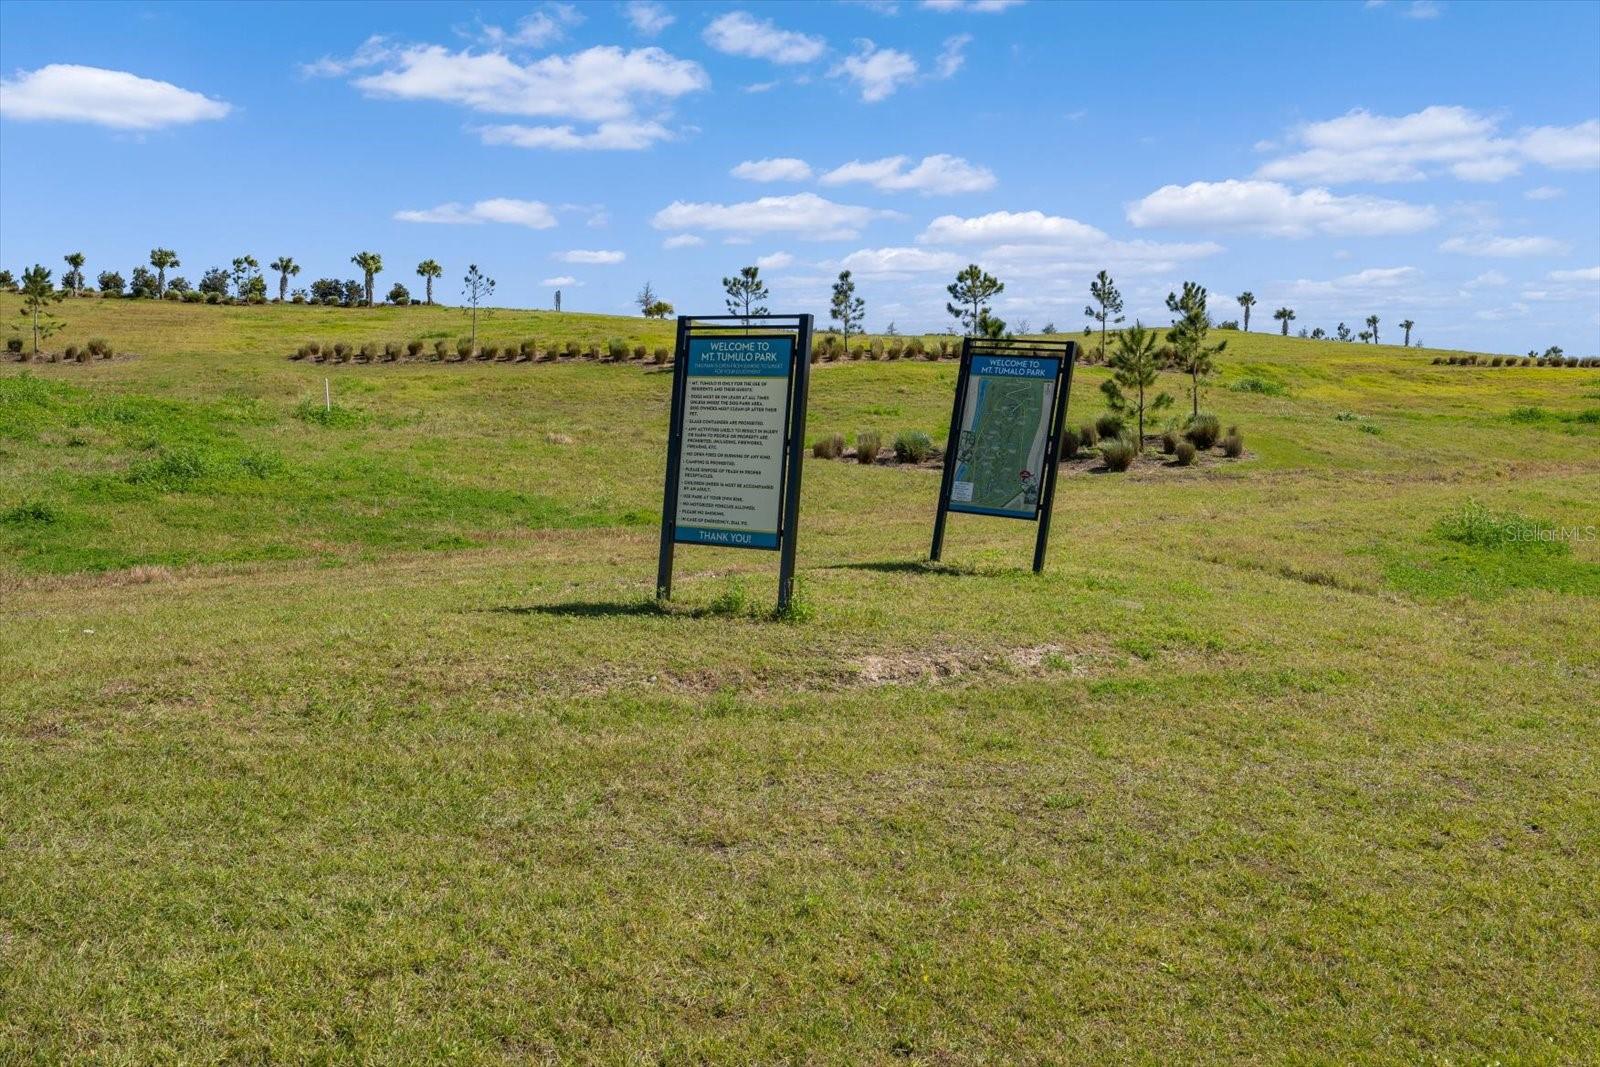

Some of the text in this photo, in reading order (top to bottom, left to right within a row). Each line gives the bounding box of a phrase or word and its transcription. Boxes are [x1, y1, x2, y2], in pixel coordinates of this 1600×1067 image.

[710, 342, 769, 351] WELCOME TO
[701, 352, 777, 361] MT. TUMULO PARK
[699, 531, 752, 541] THANK YOU!
